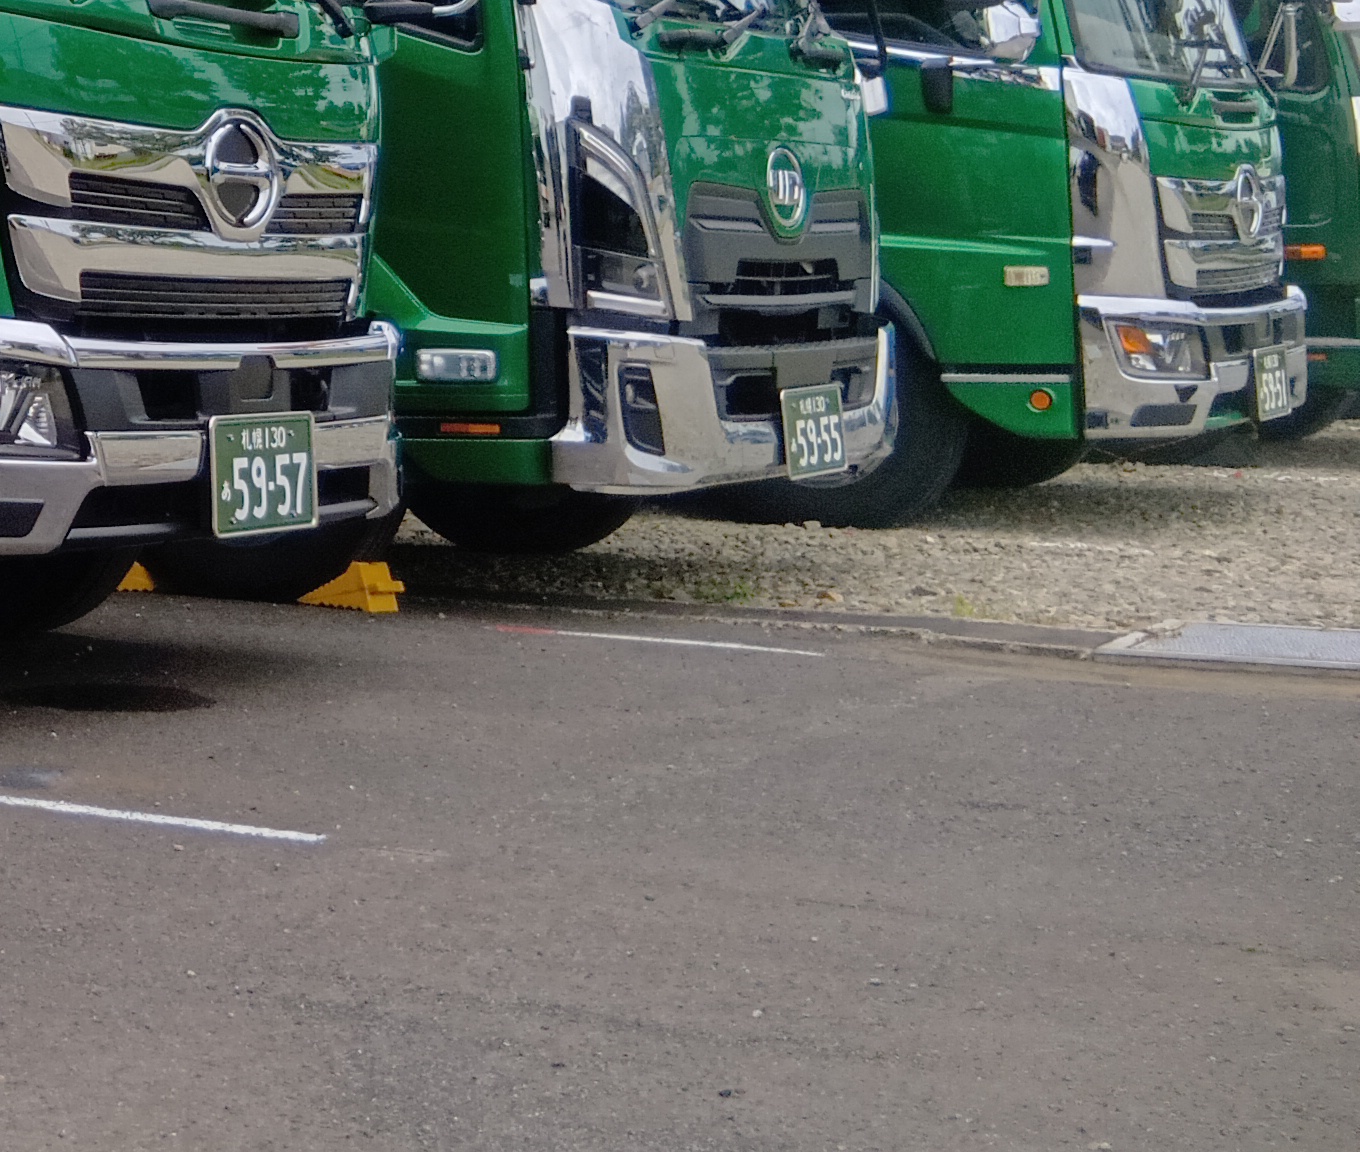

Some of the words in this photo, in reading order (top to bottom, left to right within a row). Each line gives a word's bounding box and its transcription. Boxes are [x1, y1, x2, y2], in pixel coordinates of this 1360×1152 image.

[795, 414, 842, 467] 59-55
[221, 480, 231, 501] あ
[232, 452, 307, 520] 59-57
